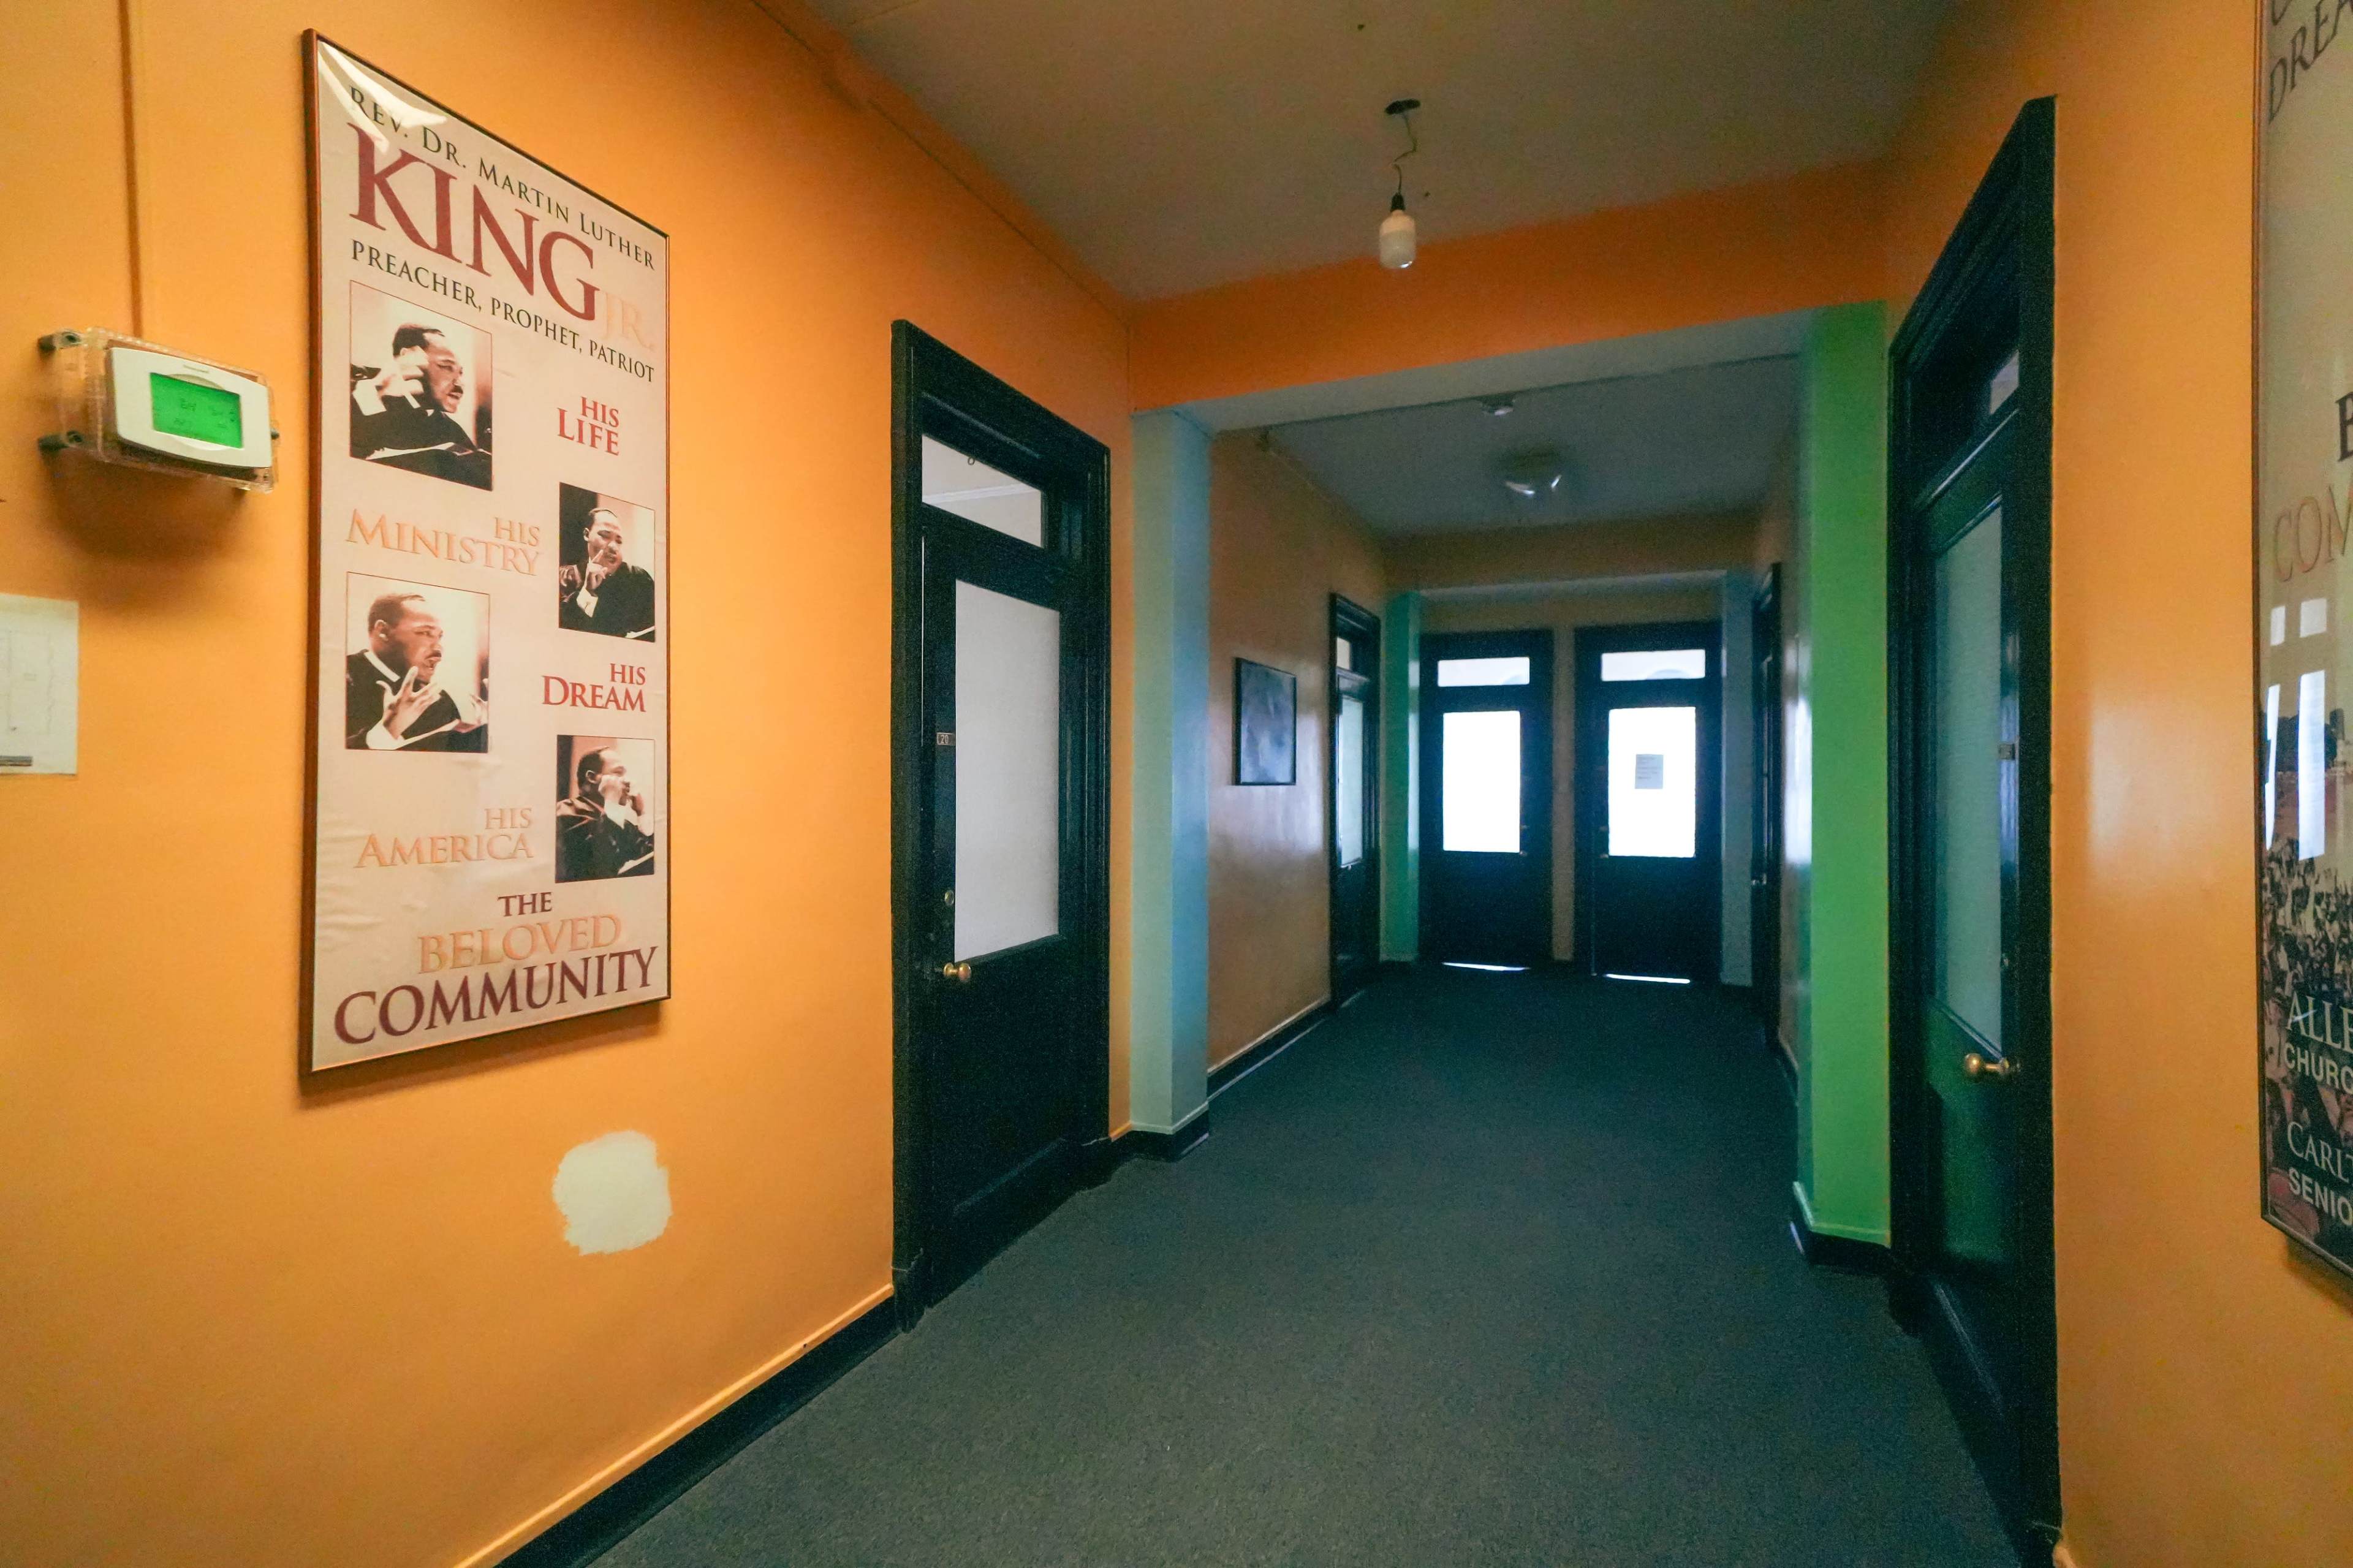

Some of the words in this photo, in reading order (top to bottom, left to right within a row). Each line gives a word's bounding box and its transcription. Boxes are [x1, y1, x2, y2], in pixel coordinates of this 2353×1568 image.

[350, 86, 408, 138] REV.
[423, 127, 466, 168] DR.
[479, 157, 569, 223] MARTIN
[580, 213, 654, 271] LUTHER
[347, 123, 600, 321] KING
[352, 238, 482, 312] PREACHER,
[490, 296, 582, 354] PROPHET,
[589, 339, 654, 382] PATRIOT
[557, 407, 619, 456] LIFE
[580, 396, 619, 428] HIS
[347, 509, 544, 576] MINISTRY
[493, 517, 540, 548] HIS
[542, 675, 646, 713] DREAM
[610, 663, 646, 685] HIS
[485, 808, 532, 830] HIS
[355, 833, 533, 869] AMERICA
[498, 892, 552, 917] THE
[417, 914, 622, 974] BELOVED
[334, 946, 658, 1044] COMMUNITY
